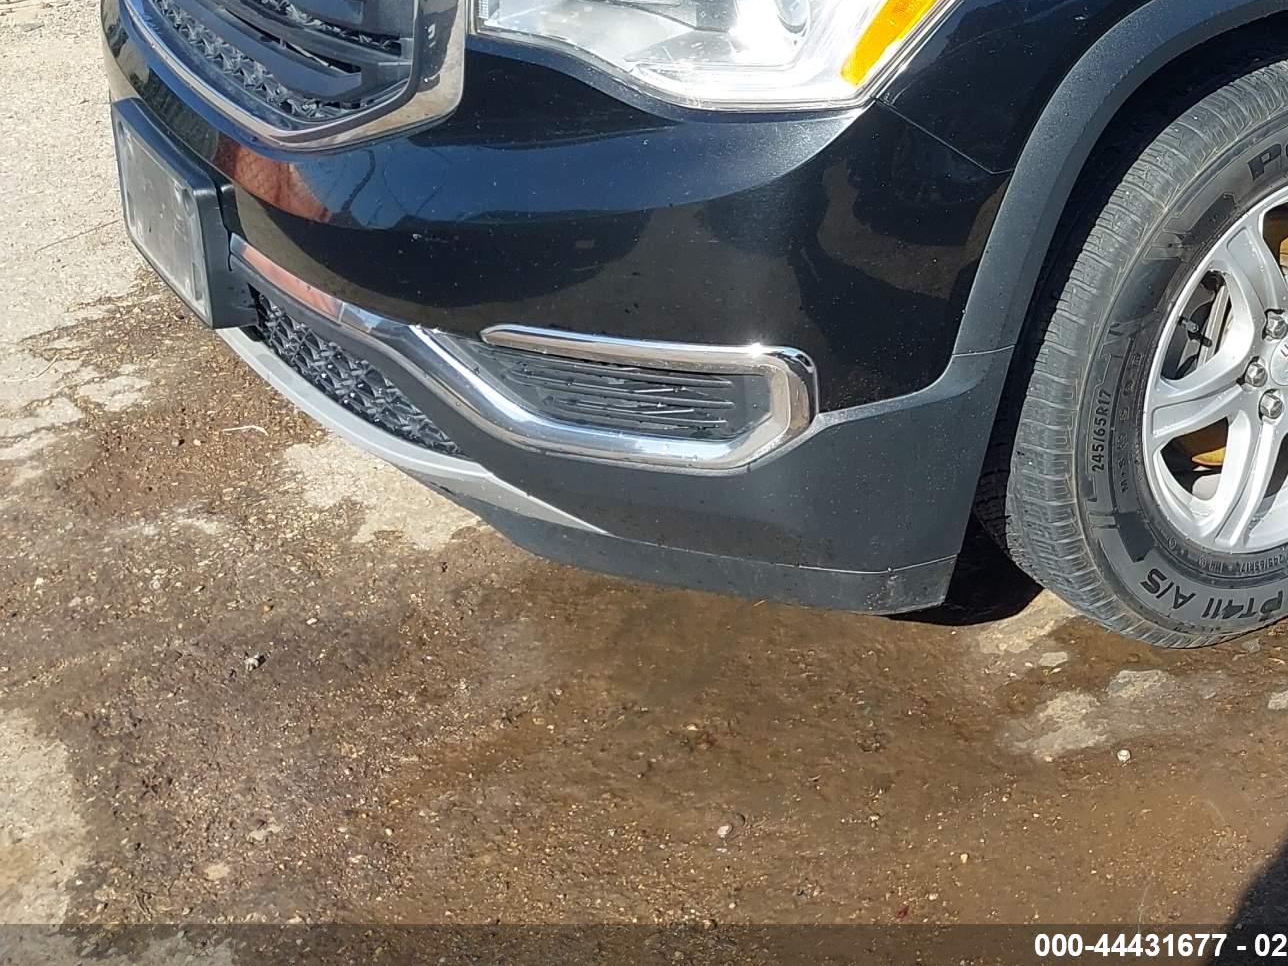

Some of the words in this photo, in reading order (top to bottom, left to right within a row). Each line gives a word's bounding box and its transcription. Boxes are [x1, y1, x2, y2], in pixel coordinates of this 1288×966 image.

[1091, 388, 1112, 474] 245/65R17
[1139, 567, 1197, 610] A/S
[1200, 589, 1284, 620] PT411
